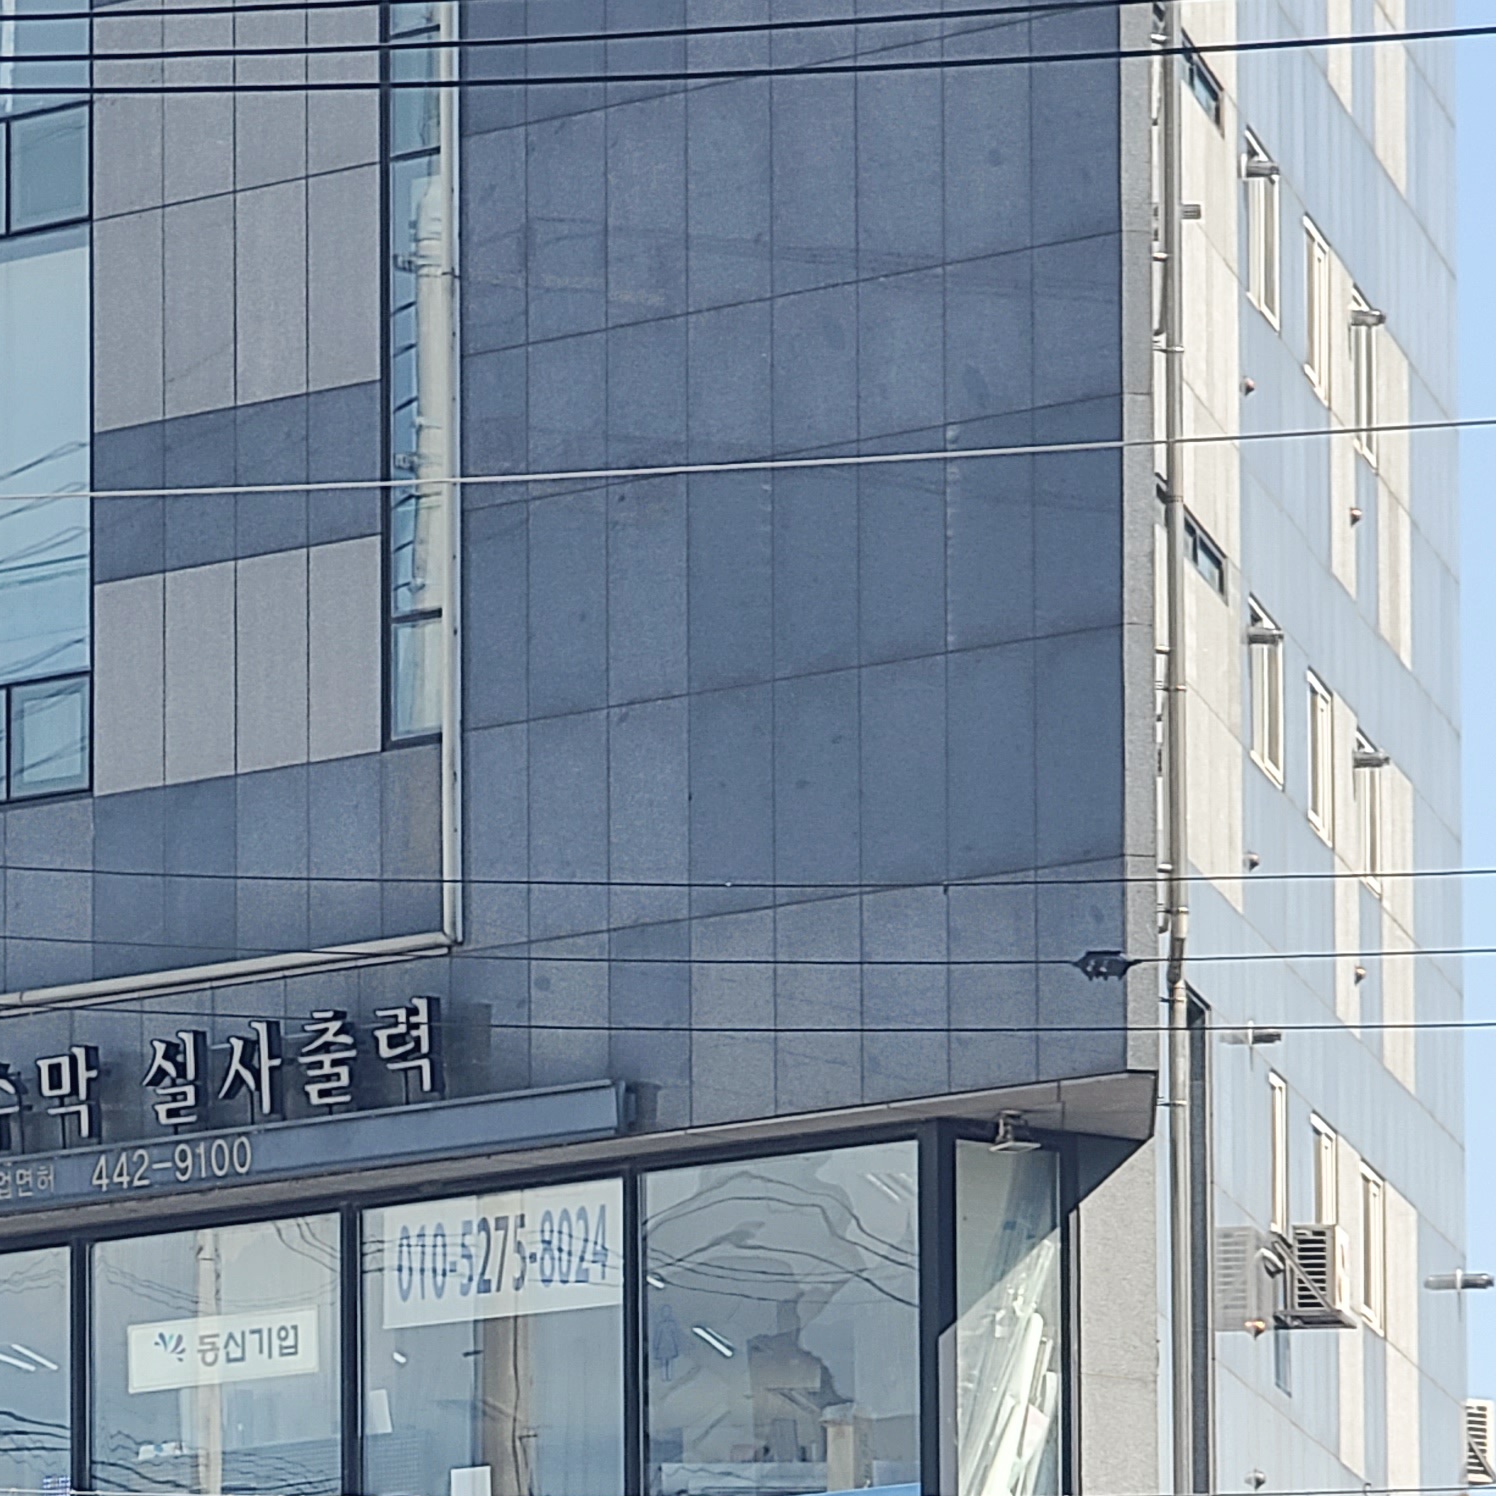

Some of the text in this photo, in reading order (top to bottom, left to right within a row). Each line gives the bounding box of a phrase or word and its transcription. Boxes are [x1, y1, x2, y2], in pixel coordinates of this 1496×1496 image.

[141, 996, 435, 1128] 실사출력
[90, 1135, 253, 1192] 442-9100
[397, 1203, 609, 1302] 010-5275-8024
[196, 1325, 300, 1367] 동신기업
